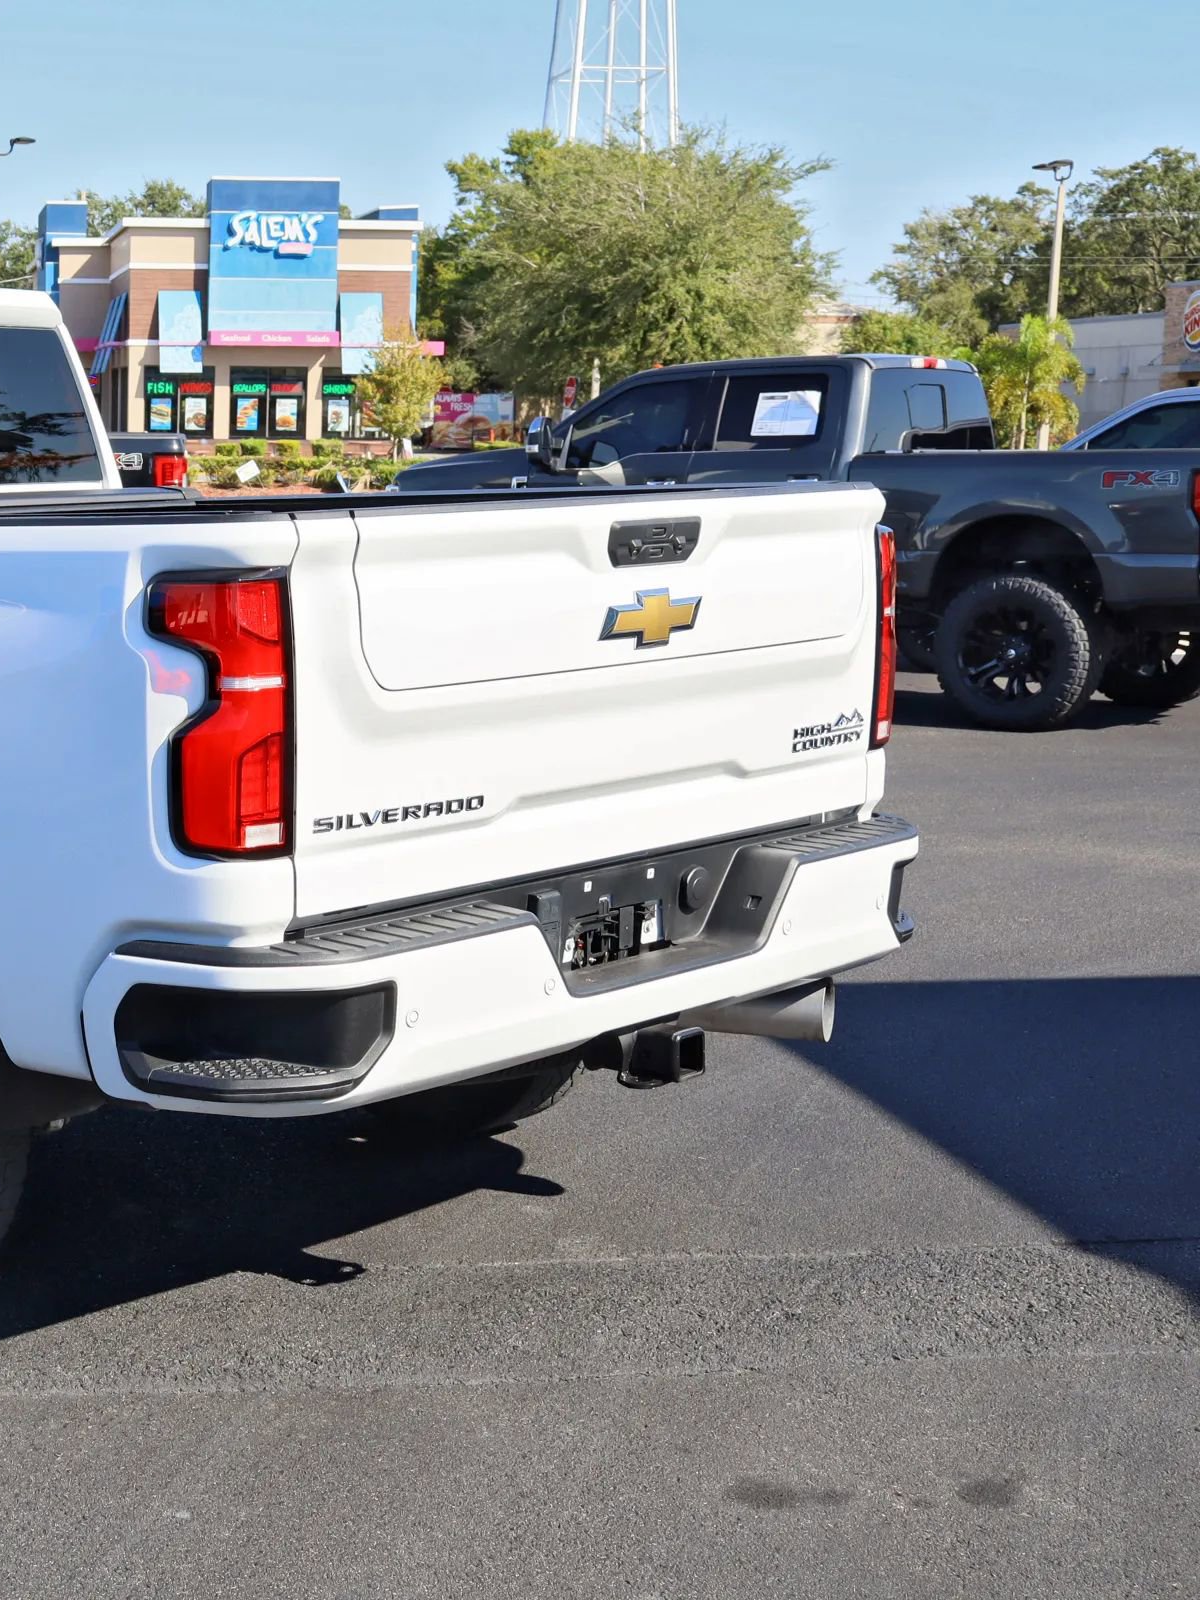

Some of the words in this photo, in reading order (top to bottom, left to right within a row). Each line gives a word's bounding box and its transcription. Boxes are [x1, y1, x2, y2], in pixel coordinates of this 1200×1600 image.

[226, 211, 325, 247] SALEM'S
[147, 382, 174, 394] FISH
[180, 382, 213, 393] WINGS
[1101, 470, 1180, 489] FX4
[791, 729, 864, 753] COUNTRY
[792, 723, 832, 740] HIGH
[312, 795, 484, 834] SILVERADO
